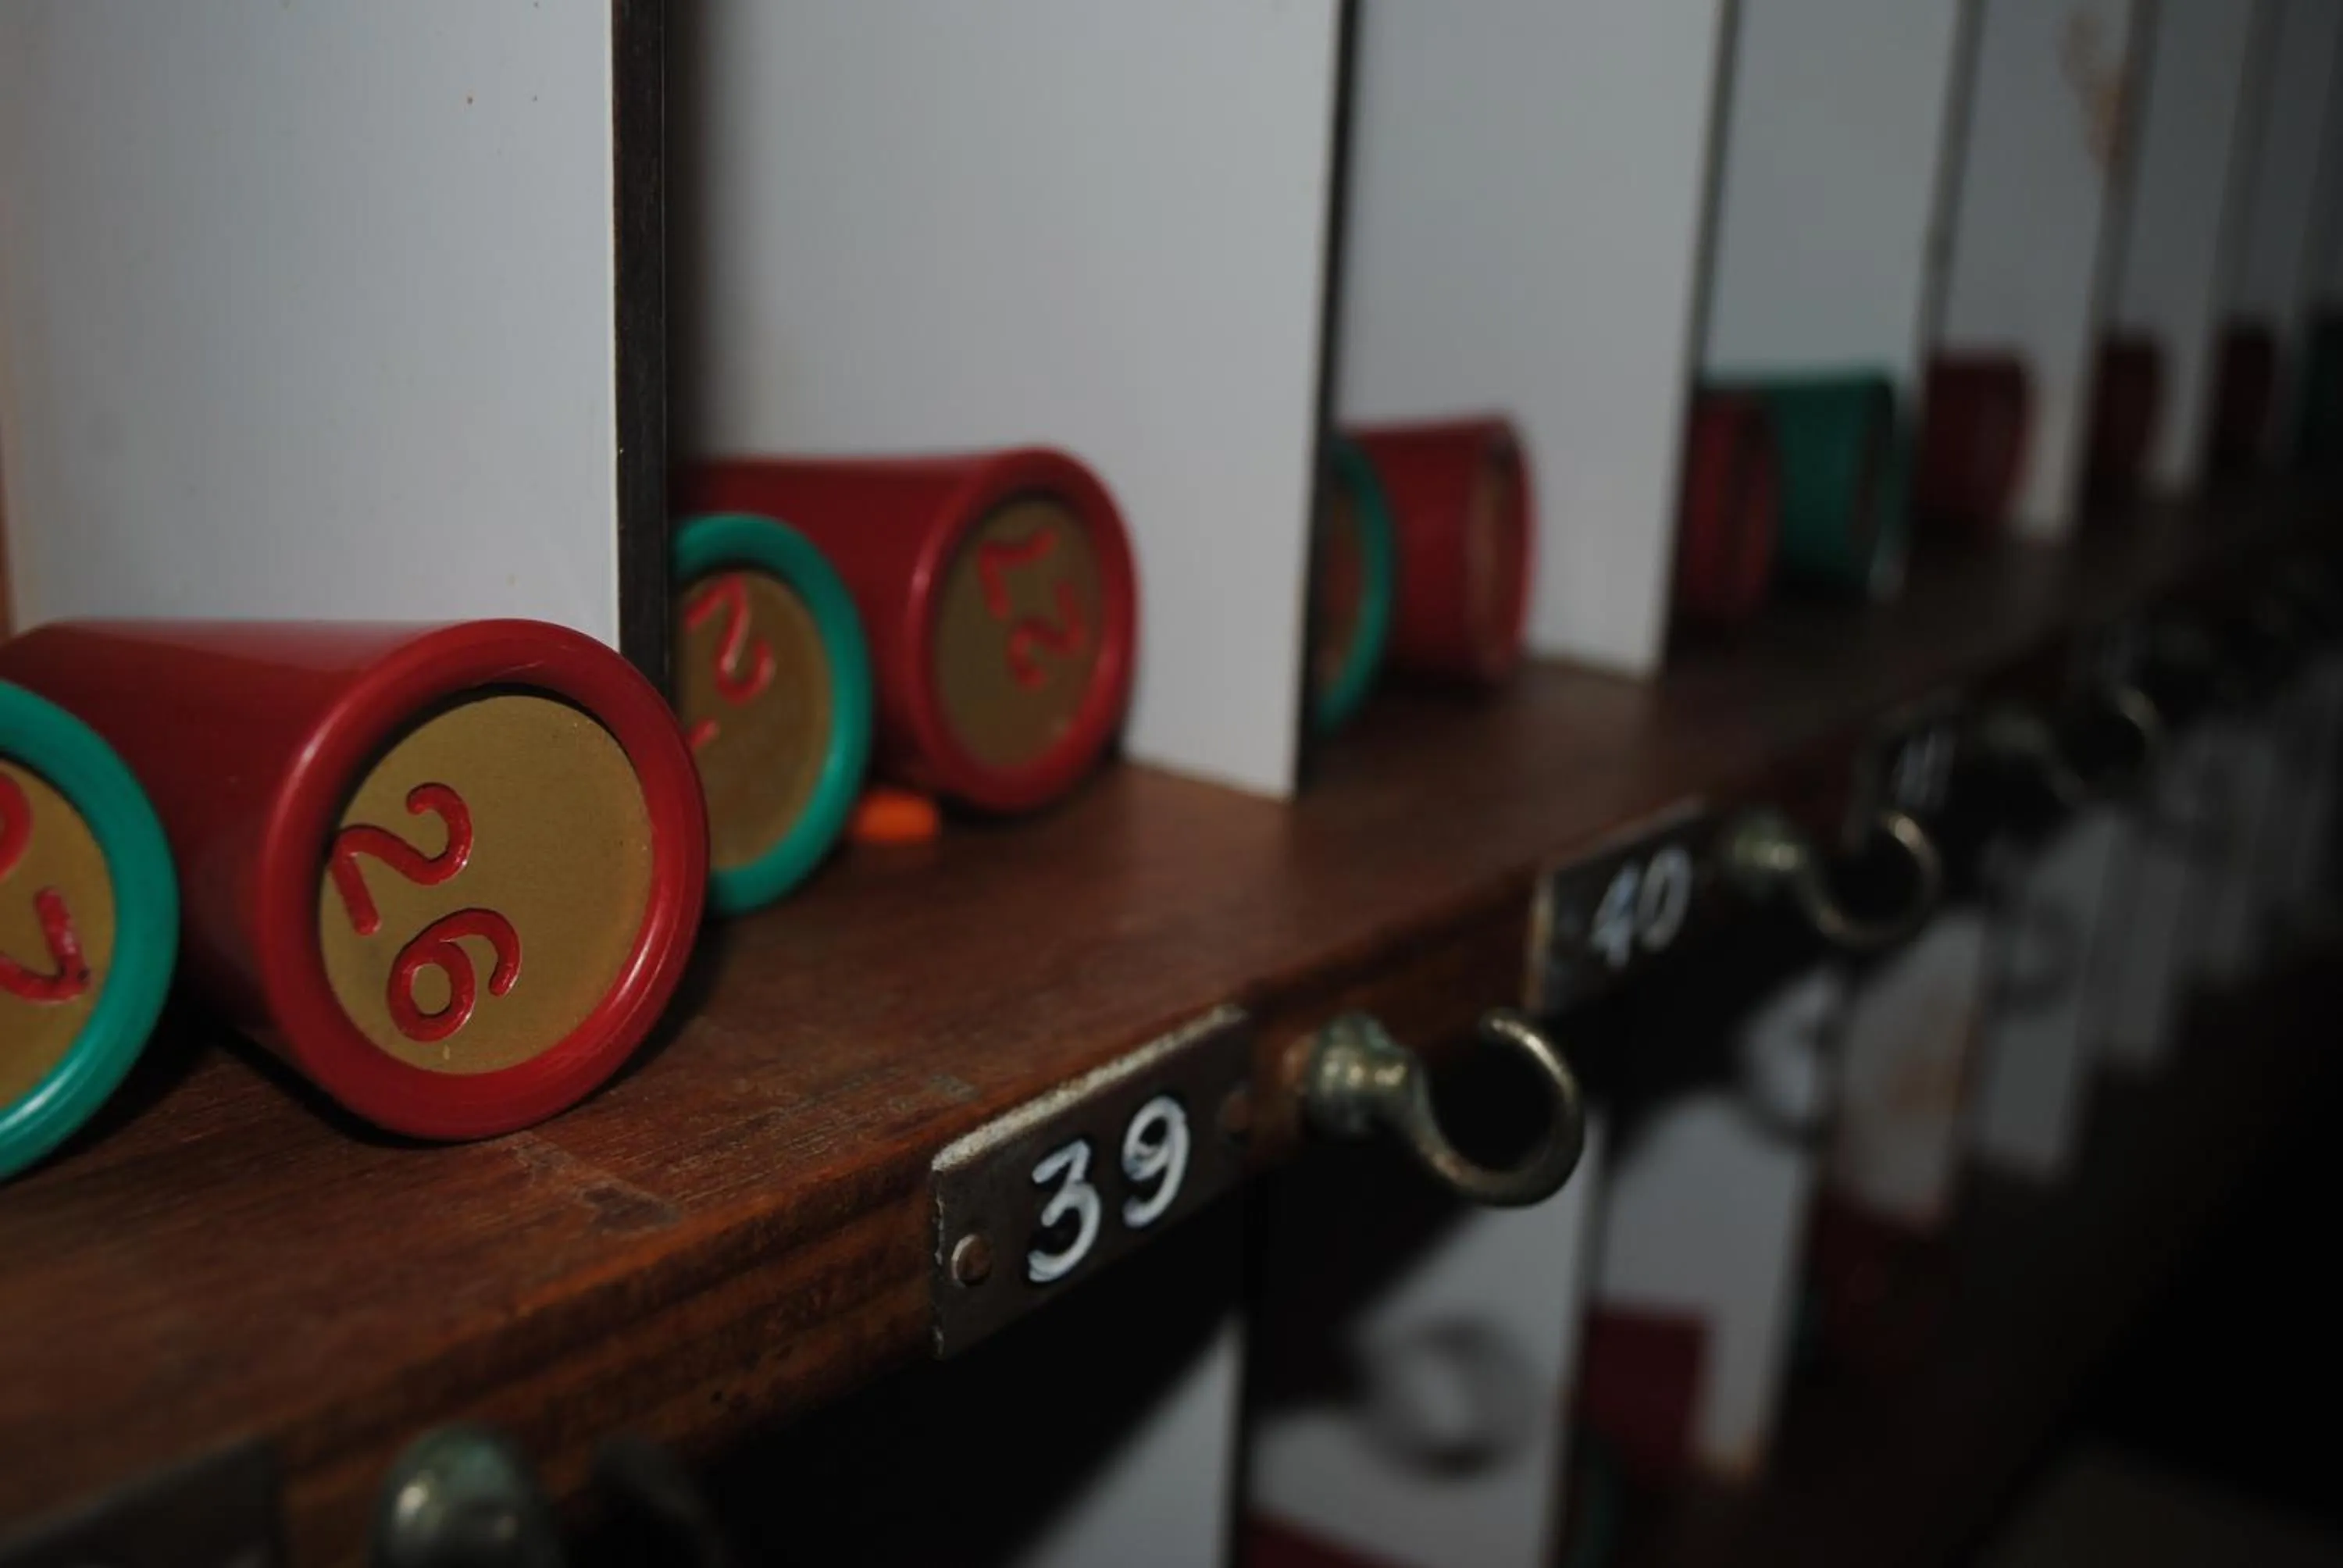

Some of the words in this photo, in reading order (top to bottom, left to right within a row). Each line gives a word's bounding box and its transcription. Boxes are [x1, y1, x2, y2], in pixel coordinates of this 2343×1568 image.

[325, 782, 522, 1043] 26
[1590, 848, 1693, 968] 40
[1027, 1095, 1190, 1282] 39
